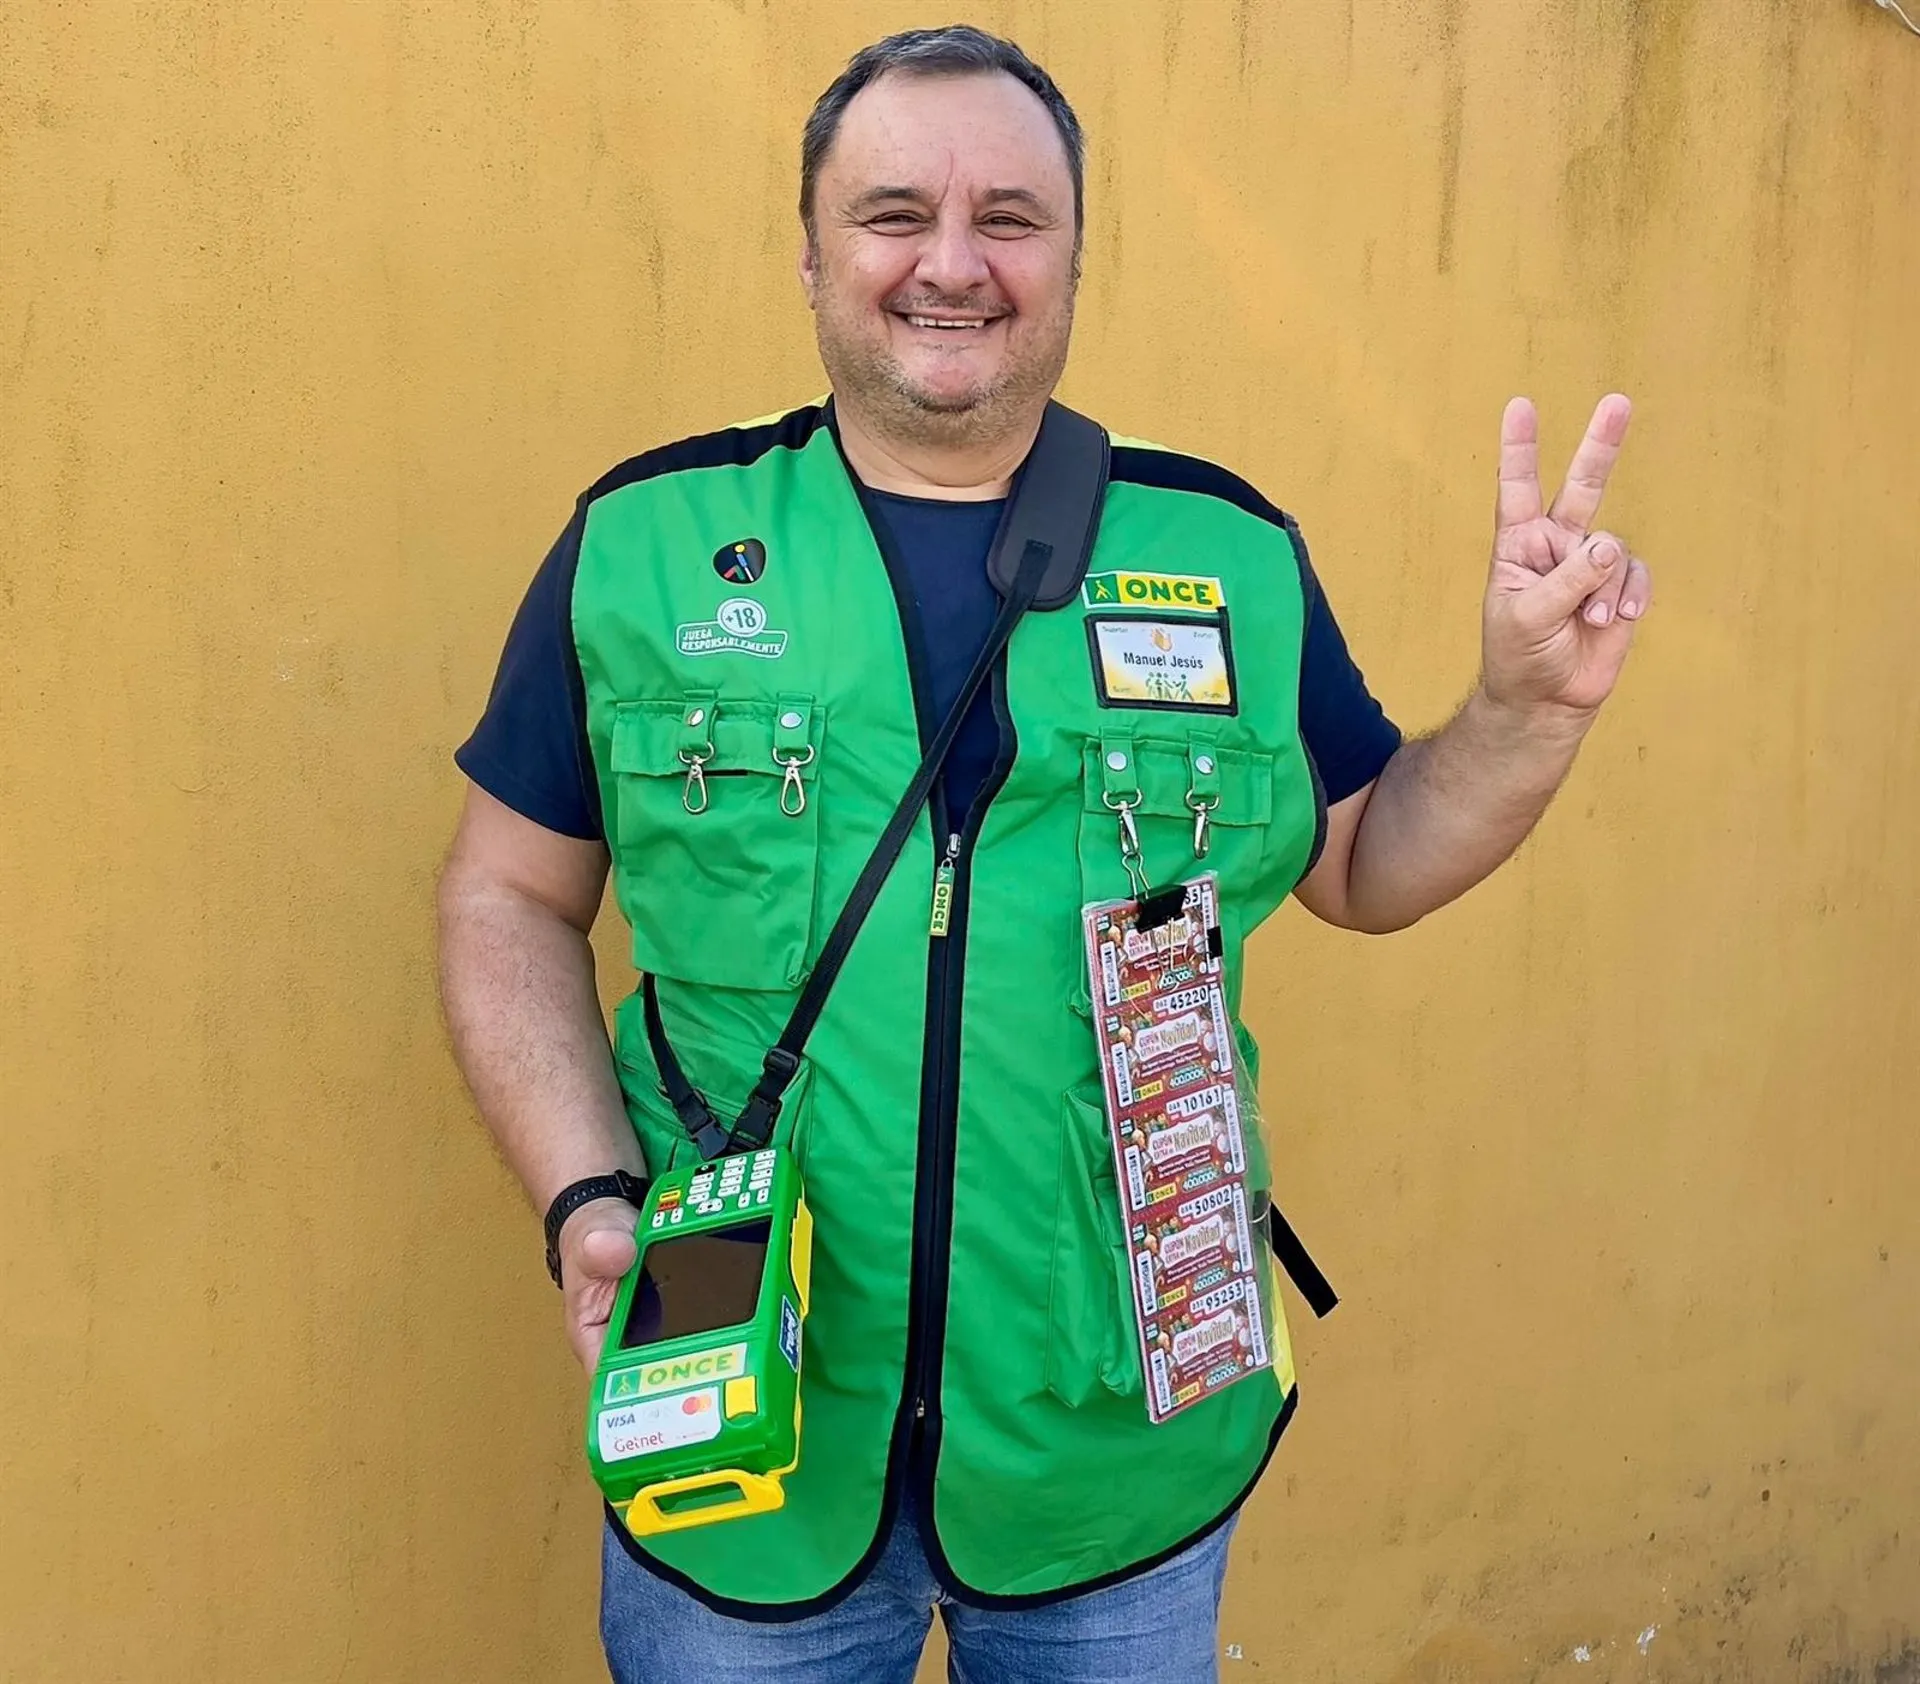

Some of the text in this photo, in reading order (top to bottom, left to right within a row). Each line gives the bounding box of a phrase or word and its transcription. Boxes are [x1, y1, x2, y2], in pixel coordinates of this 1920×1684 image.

[1125, 578, 1213, 606] ONCE
[725, 606, 758, 629] +18
[681, 637, 782, 654] RESPONSABLEMENTE
[682, 628, 713, 641] JUEGA
[1123, 652, 1204, 669] Manuel Jesús
[933, 886, 949, 930] ONCE
[1170, 988, 1207, 1010] 45220
[1160, 1018, 1197, 1048] Navidad
[1142, 1083, 1161, 1096] ONCE
[1184, 1089, 1220, 1113] 10161
[1173, 1120, 1210, 1151] Navidad
[1154, 1186, 1174, 1199] ONCE
[1194, 1189, 1230, 1215] 50802
[1185, 1220, 1220, 1254] Navidad
[1165, 1288, 1185, 1302] ONCE
[1205, 1282, 1241, 1310] 95253
[647, 1352, 733, 1386] ONCE
[606, 1413, 636, 1429] VISA
